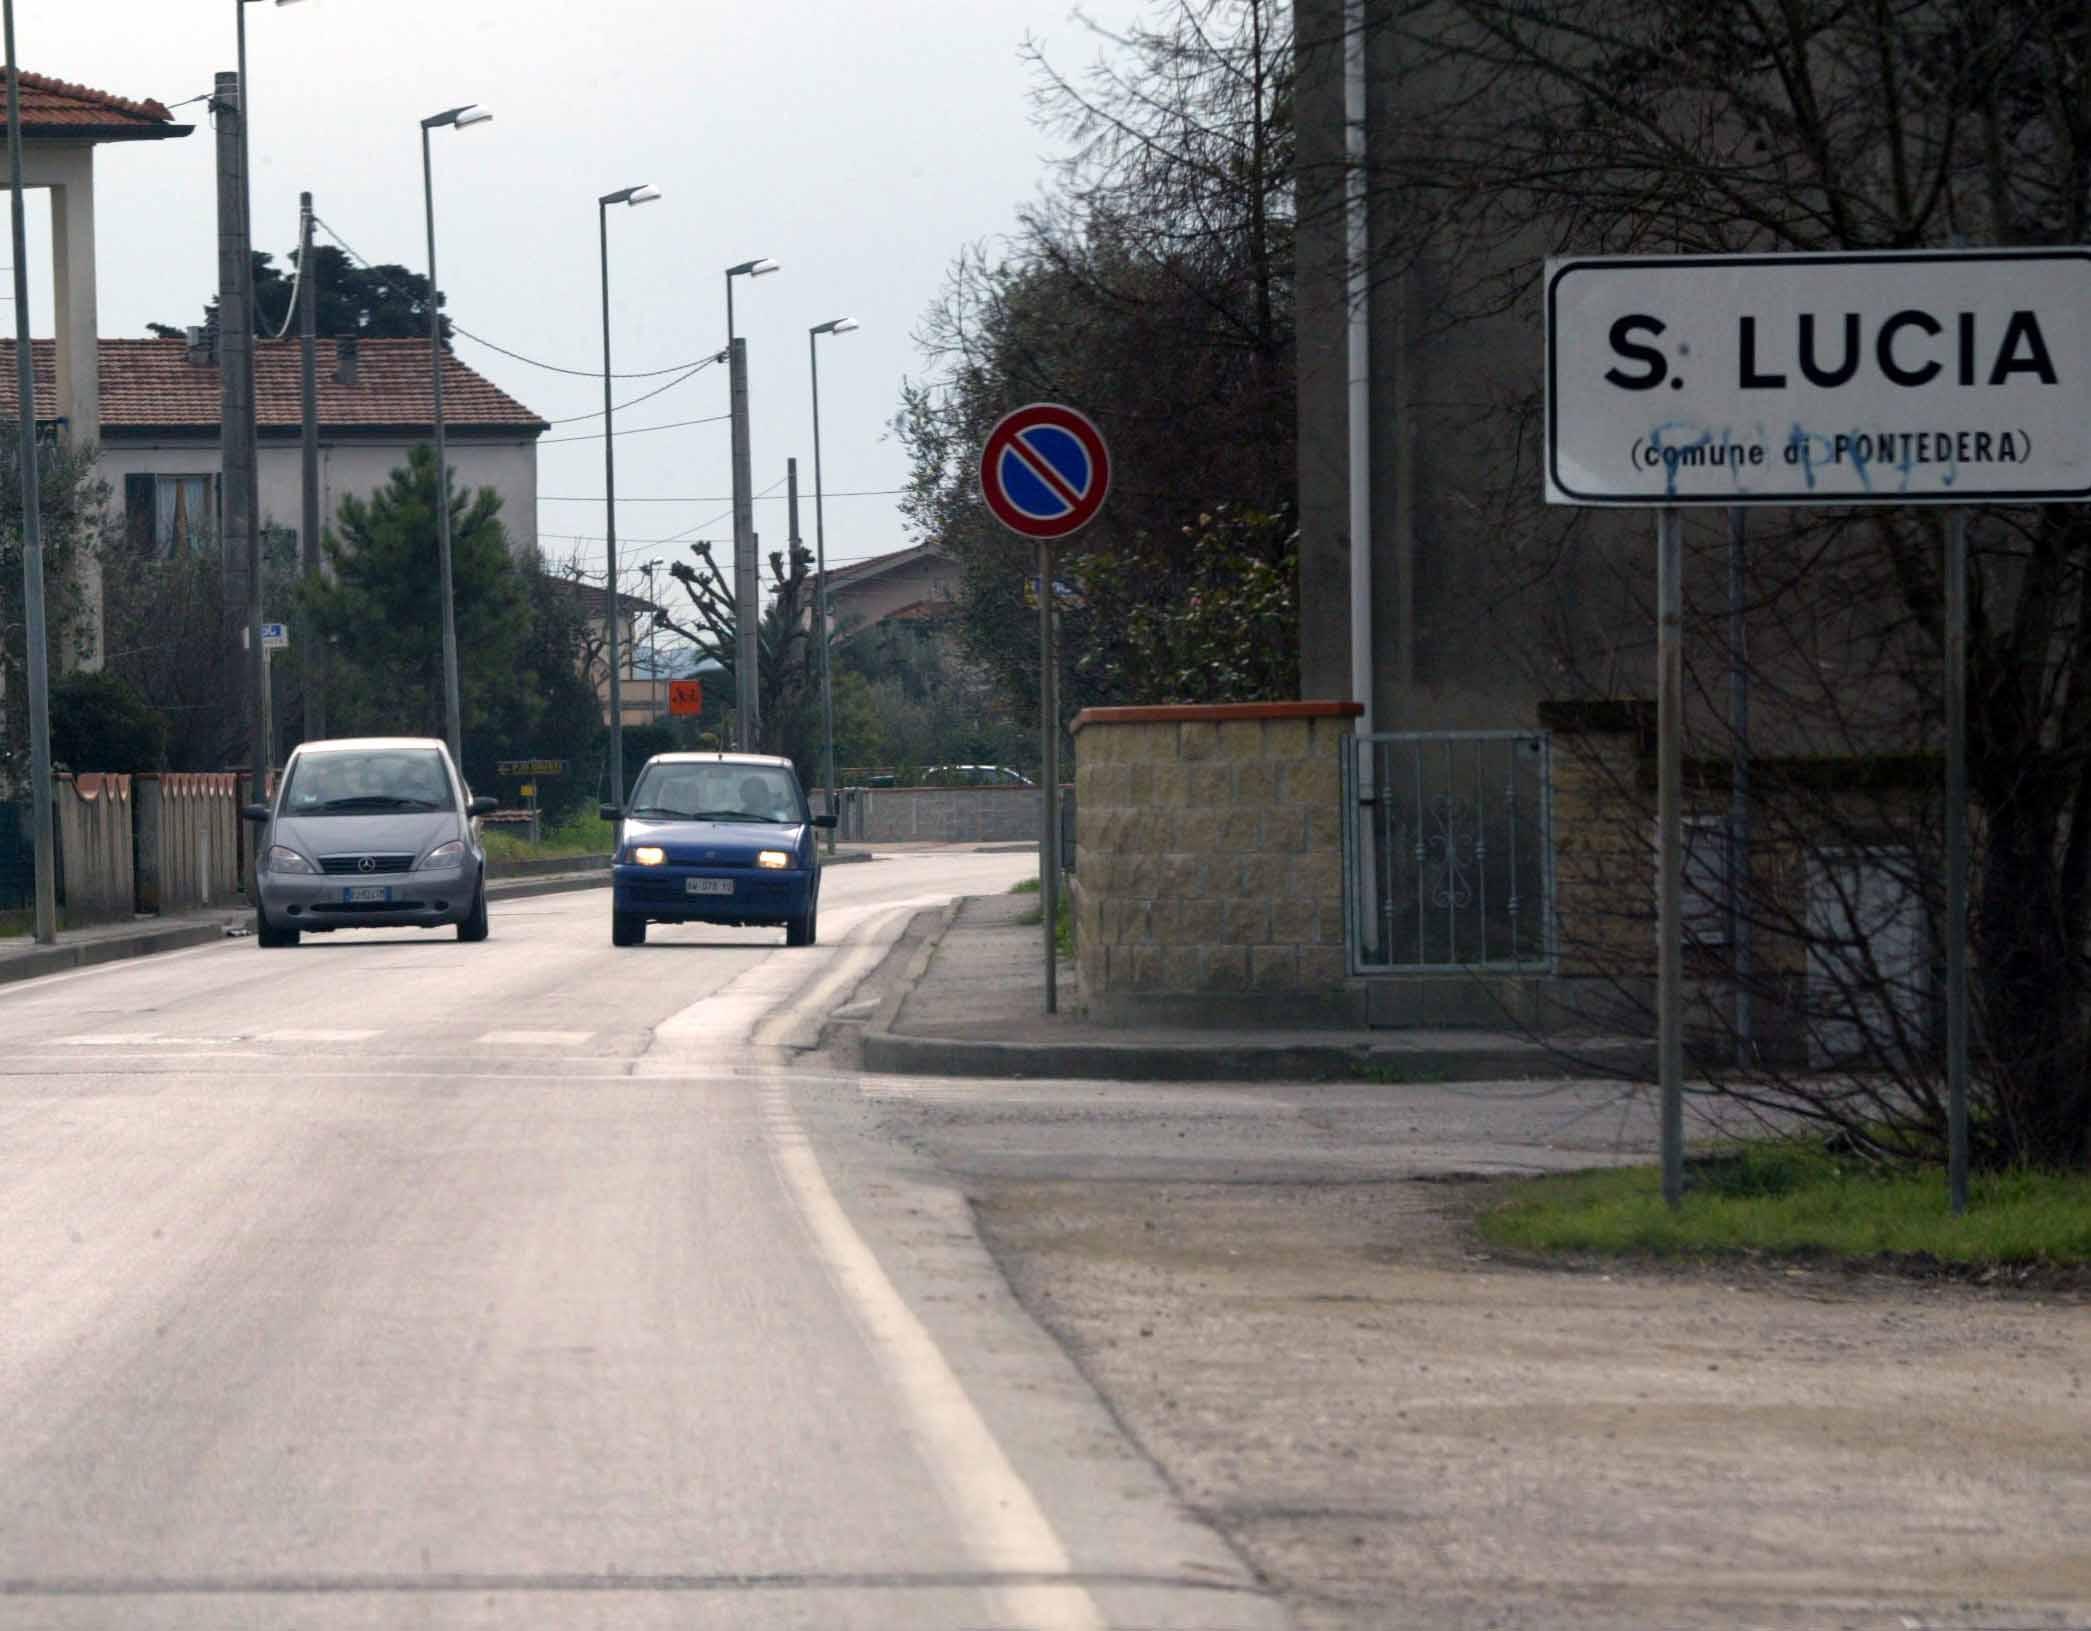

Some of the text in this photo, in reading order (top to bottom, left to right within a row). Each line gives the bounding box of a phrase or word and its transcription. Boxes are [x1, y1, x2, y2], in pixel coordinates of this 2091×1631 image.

[1603, 309, 2059, 391] S. LUCIA
[1631, 436, 1765, 472] (comune
[1783, 433, 1811, 466] di
[1834, 428, 2032, 465] PONTEDERA)
